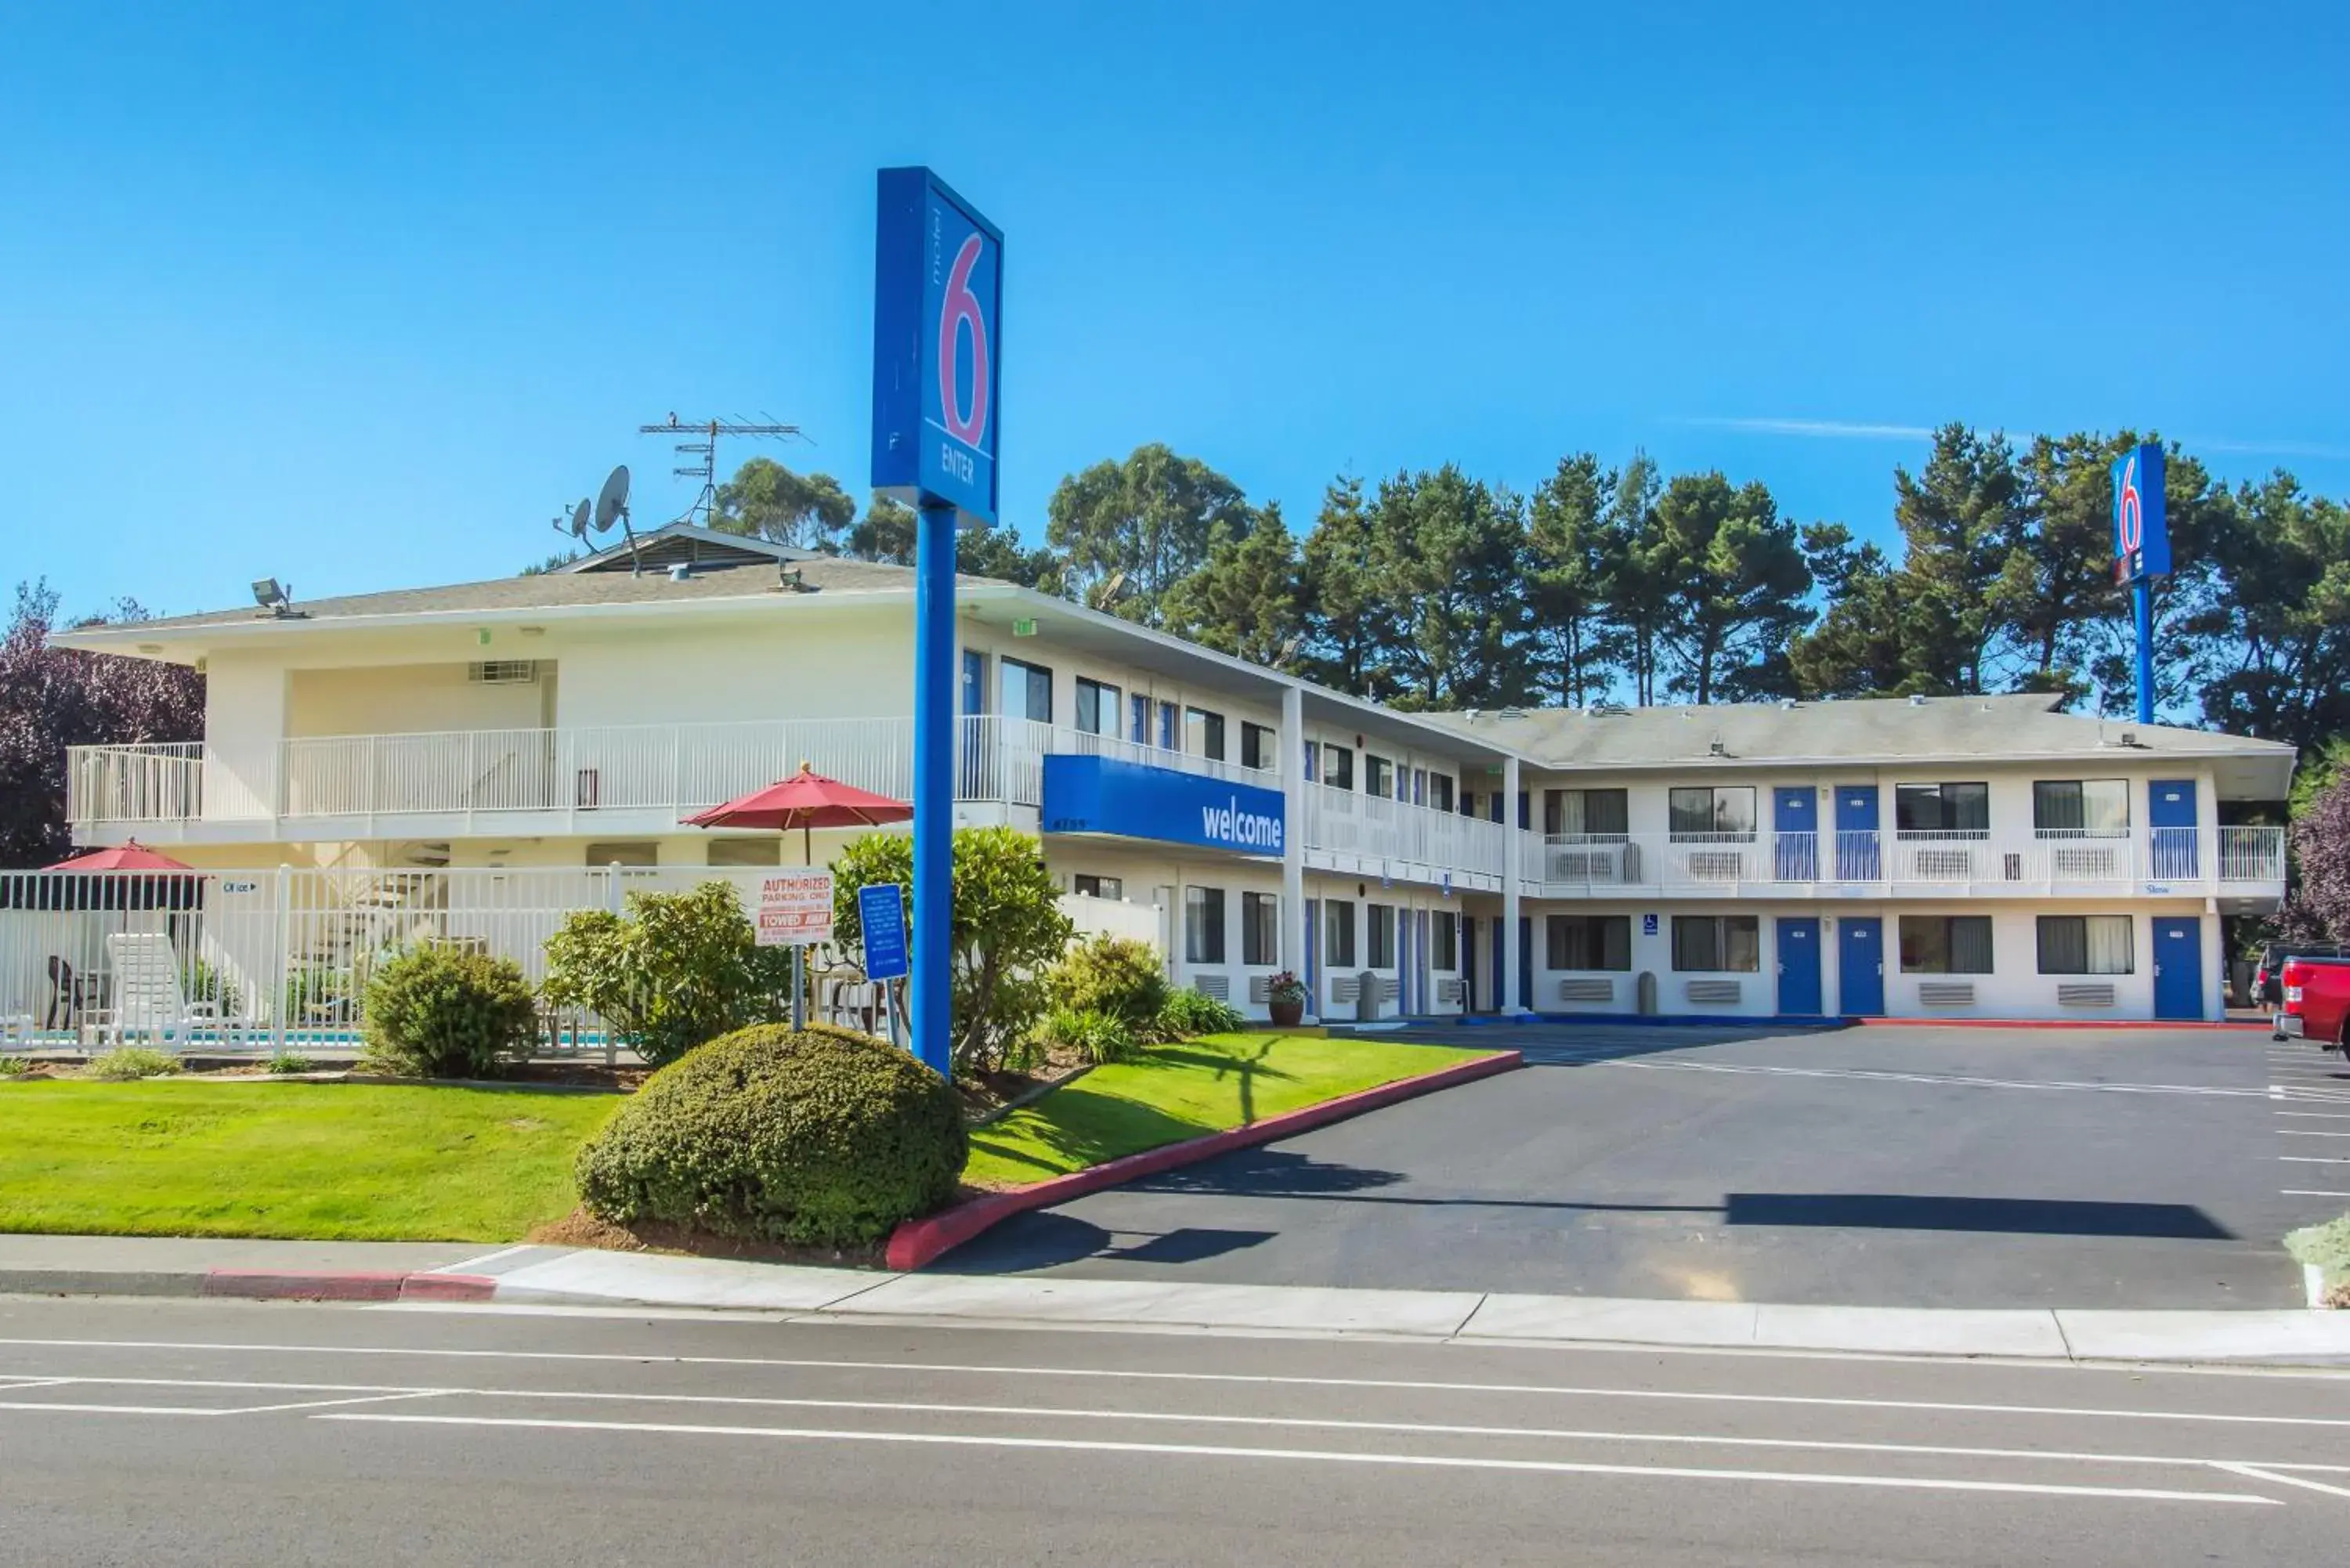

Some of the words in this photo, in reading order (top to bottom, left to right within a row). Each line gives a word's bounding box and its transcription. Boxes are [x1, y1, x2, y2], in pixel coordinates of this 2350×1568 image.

[932, 207, 942, 285] motel
[939, 232, 989, 449] 6
[942, 443, 974, 486] ENTER
[2120, 457, 2140, 557] 6
[1202, 796, 1282, 848] welcome
[762, 893, 805, 902] PARKING
[764, 876, 830, 891] AUTHORIZED
[763, 914, 801, 928] TOWED
